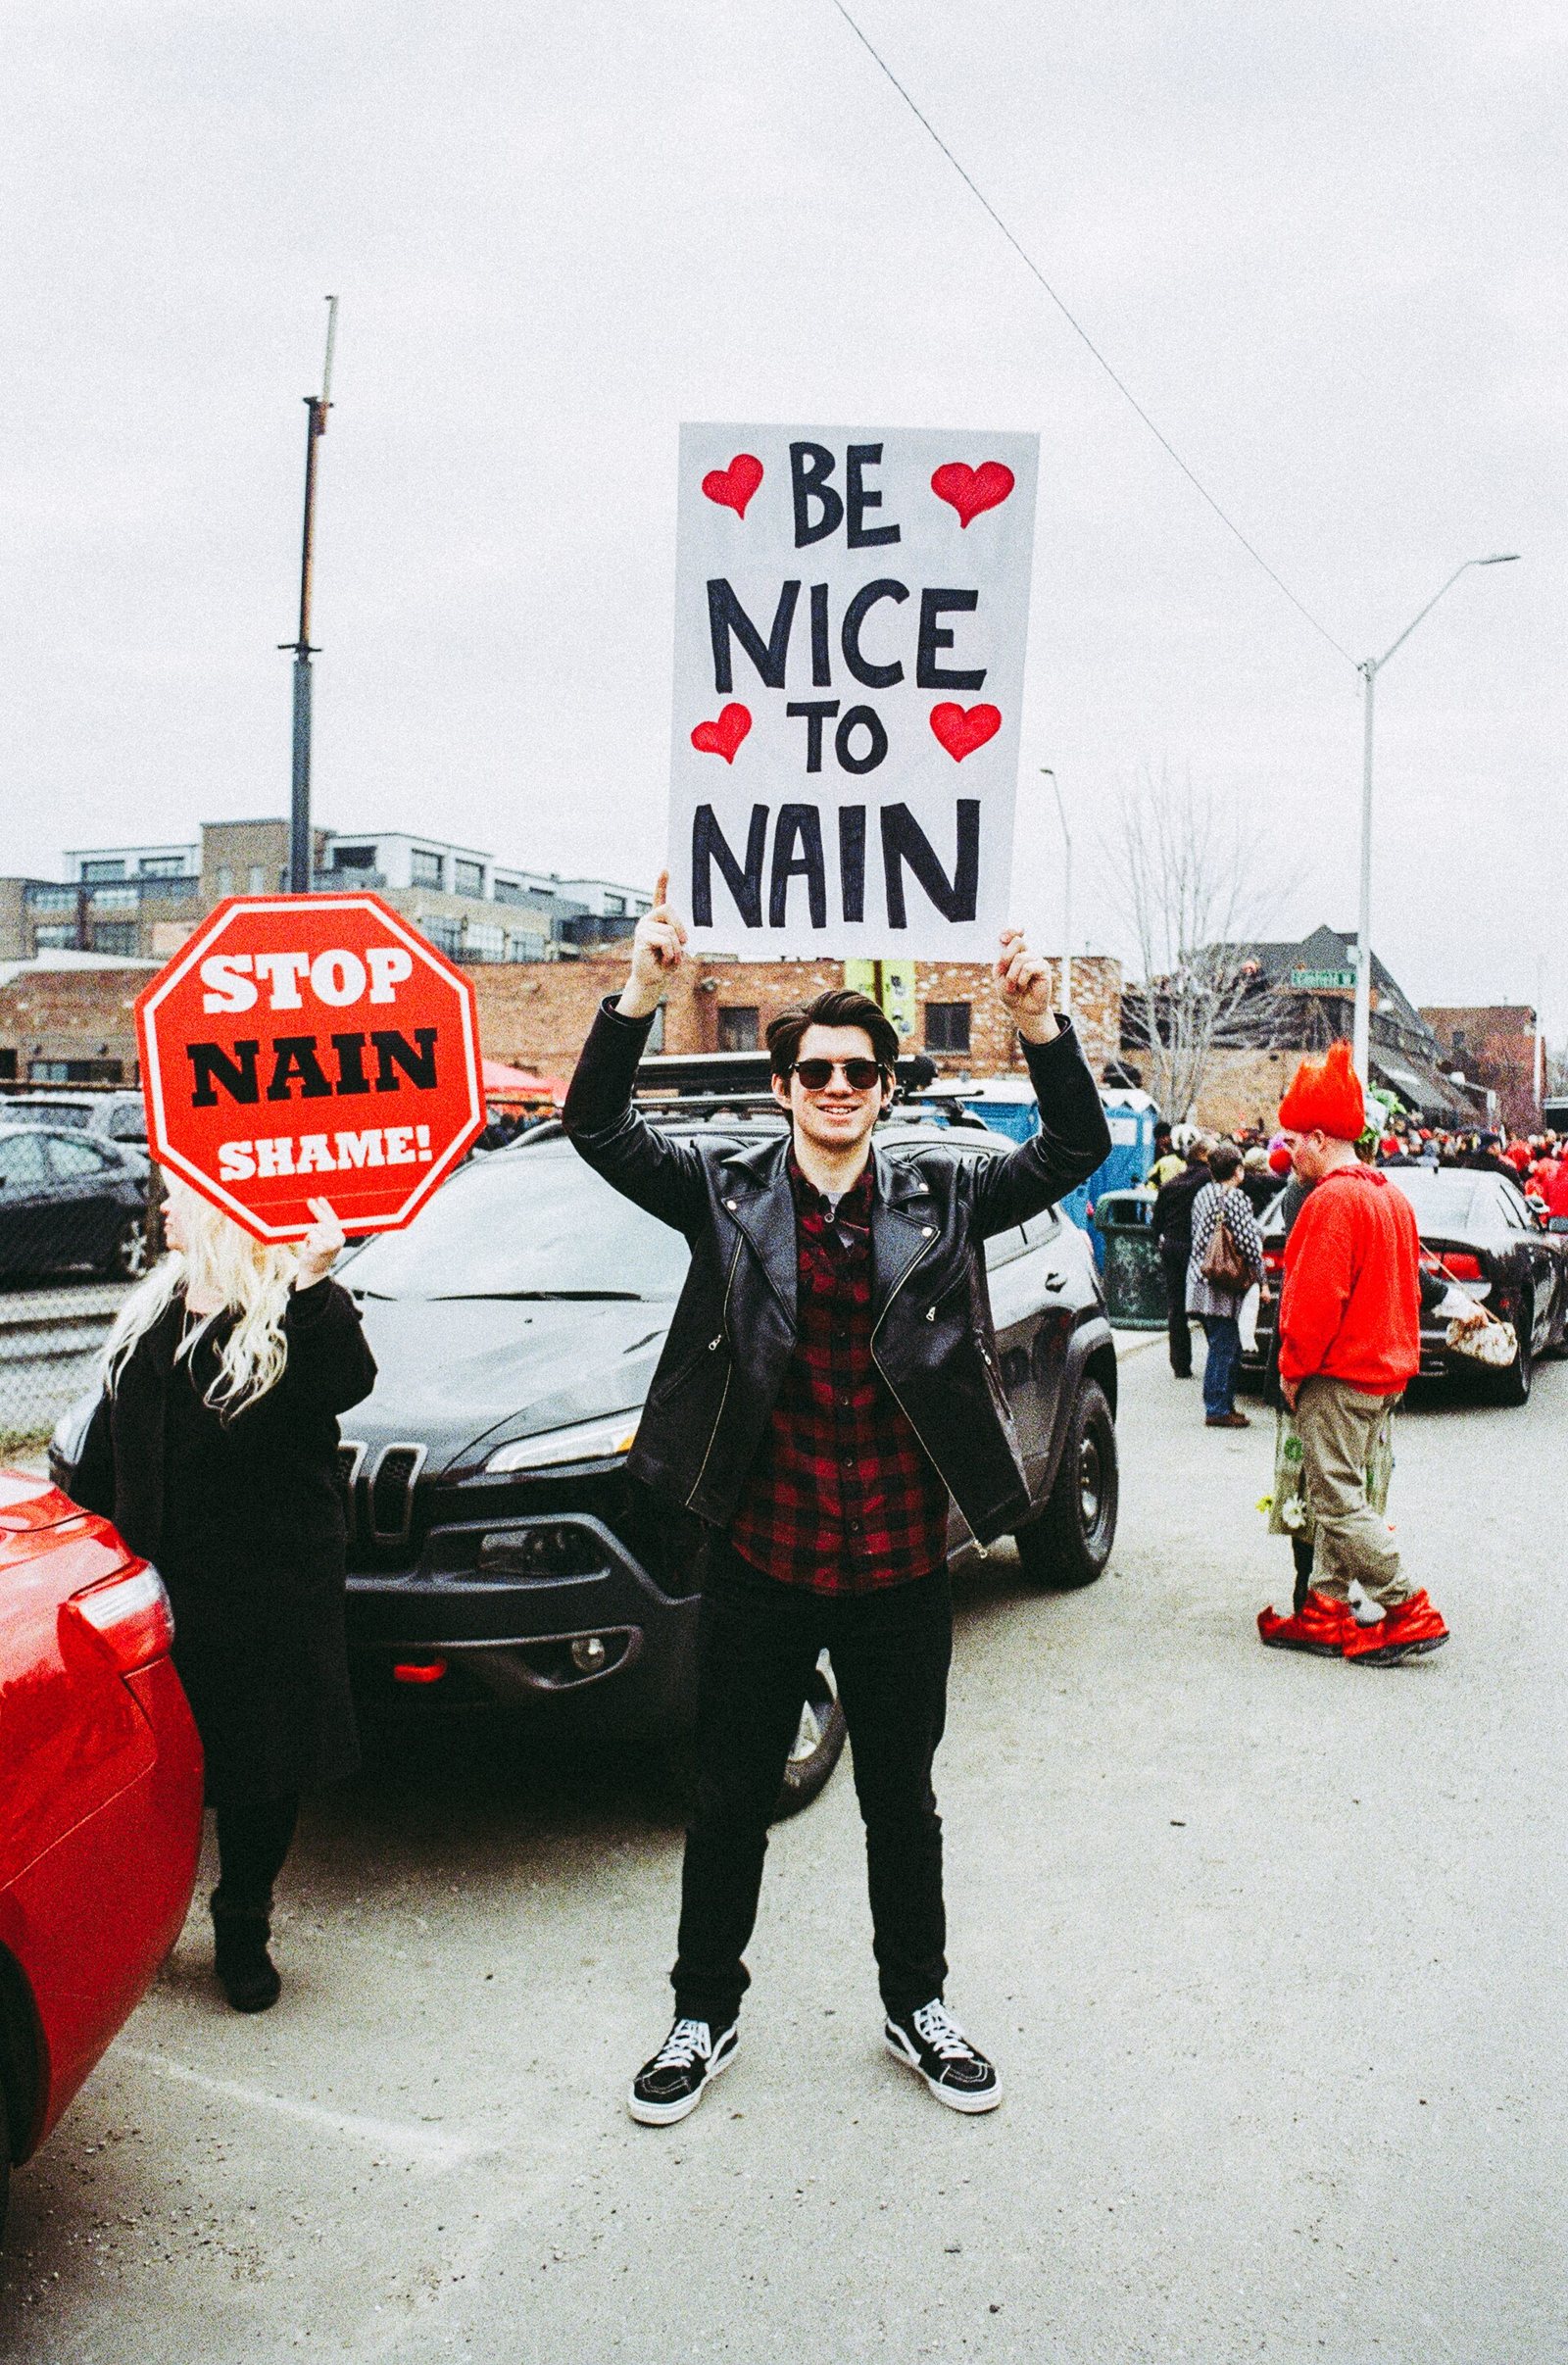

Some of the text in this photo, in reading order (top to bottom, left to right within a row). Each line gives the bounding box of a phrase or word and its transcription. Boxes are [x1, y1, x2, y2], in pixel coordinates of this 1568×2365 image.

[790, 442, 900, 548] BE
[708, 579, 986, 693] NICE
[787, 701, 887, 773] TO
[693, 800, 979, 928] NAIN
[200, 948, 413, 1013] STOP
[187, 1029, 438, 1107] NAIN
[219, 1125, 432, 1181] SHAME!
